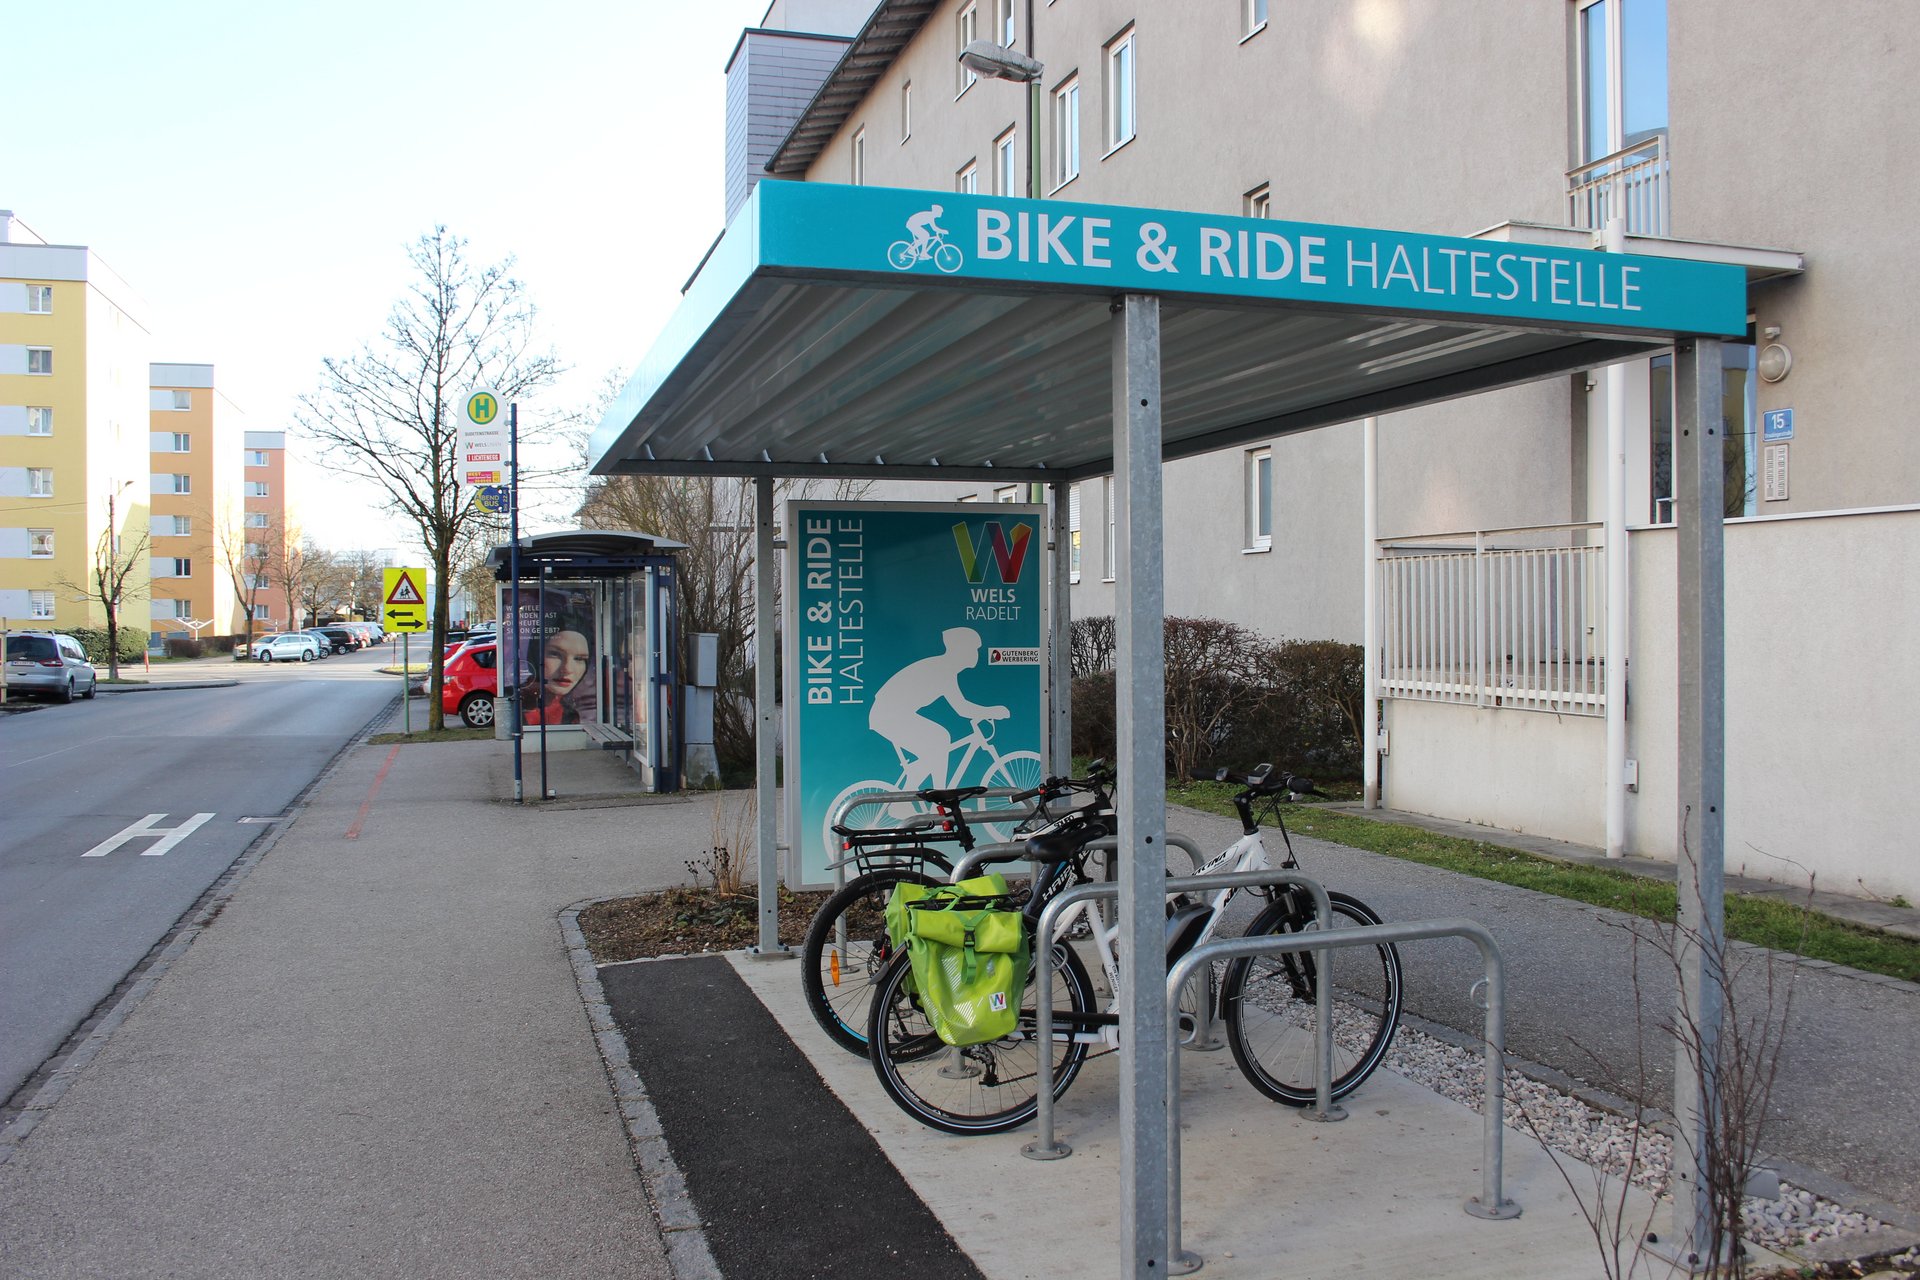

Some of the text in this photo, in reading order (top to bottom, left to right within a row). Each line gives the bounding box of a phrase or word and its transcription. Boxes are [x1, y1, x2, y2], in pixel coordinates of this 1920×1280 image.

[977, 208, 1642, 310] BIKE & RIDE HALTESTELLE
[475, 399, 489, 418] H
[1771, 413, 1785, 429] 15
[807, 518, 832, 704] BIKE & RIDE
[838, 519, 864, 704] HALTESTELLE
[970, 588, 1016, 603] WELS
[966, 606, 1021, 621] RADELT
[82, 812, 216, 857] H
